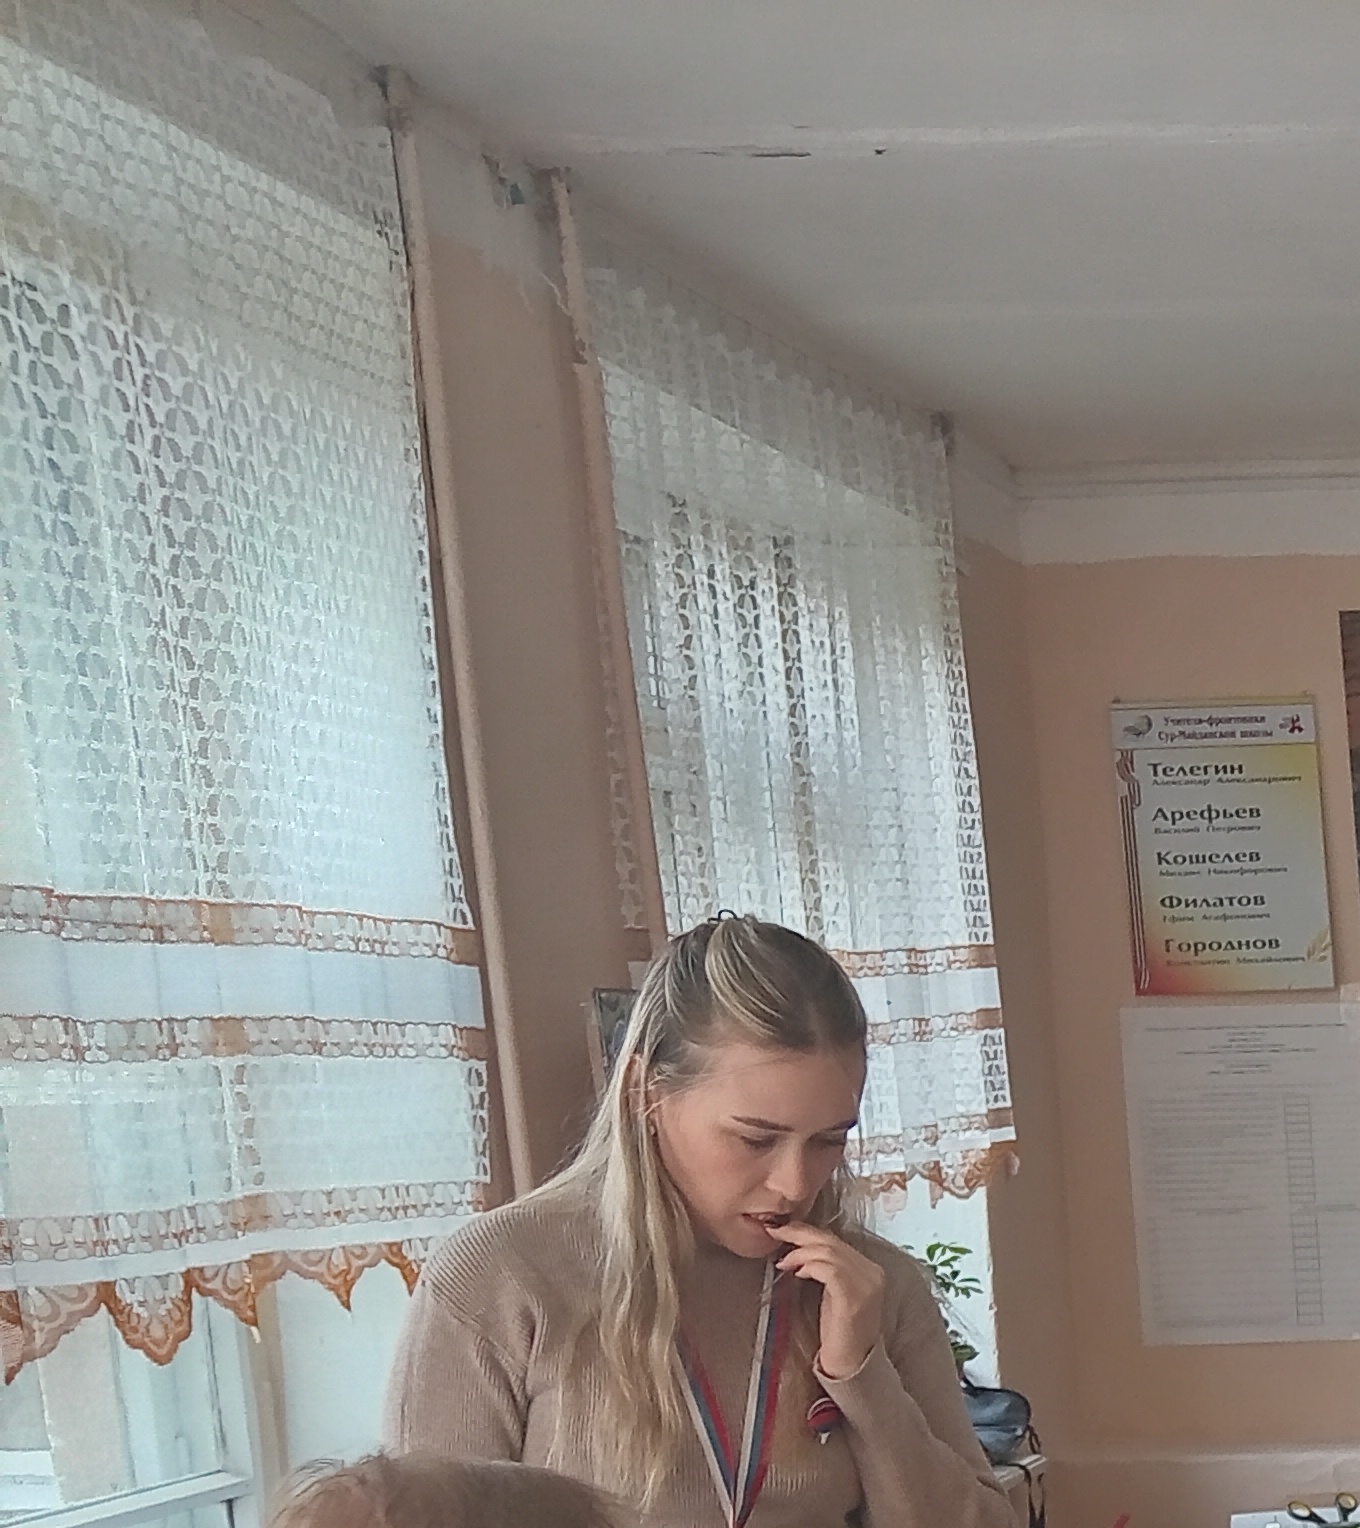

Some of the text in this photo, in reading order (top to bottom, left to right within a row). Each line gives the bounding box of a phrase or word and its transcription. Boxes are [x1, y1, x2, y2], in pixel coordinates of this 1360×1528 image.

[1148, 762, 1244, 777] Телегин
[1152, 804, 1261, 826] Арефьев
[1156, 851, 1261, 866] Кошелев
[1159, 894, 1266, 909] Филатов
[1164, 938, 1281, 956] Городнов
